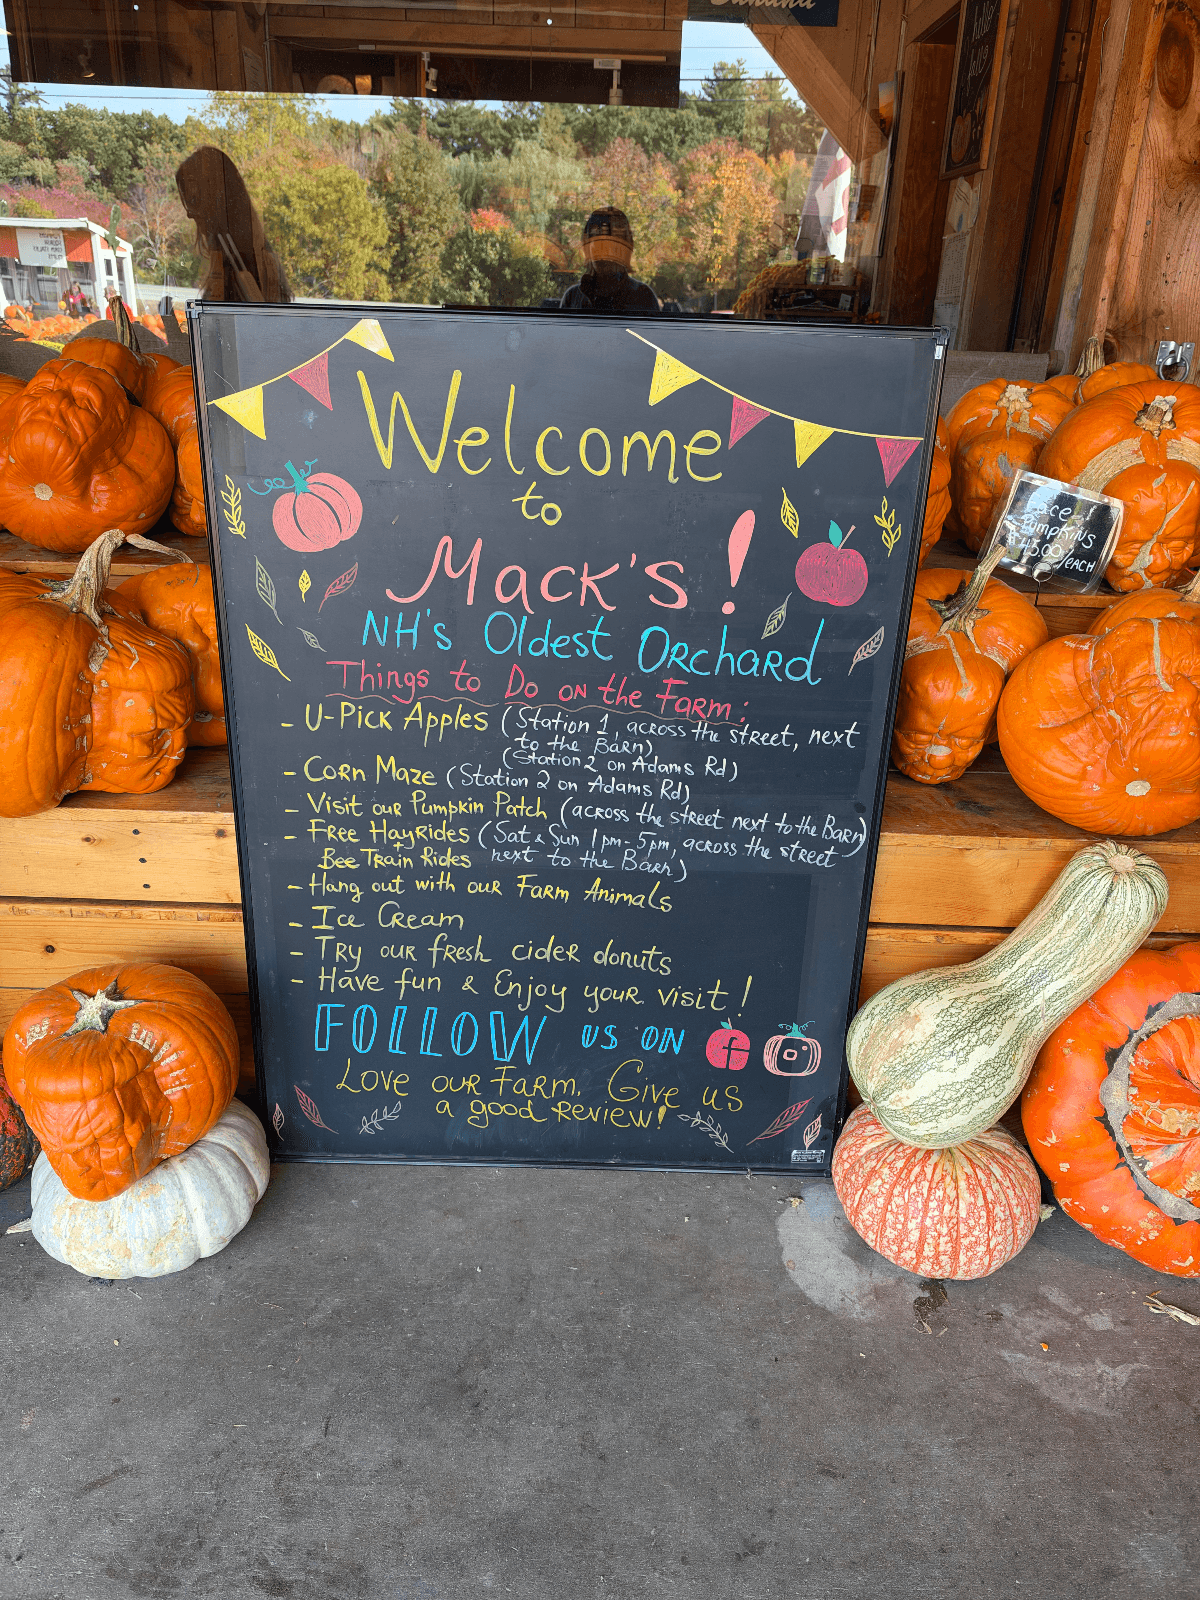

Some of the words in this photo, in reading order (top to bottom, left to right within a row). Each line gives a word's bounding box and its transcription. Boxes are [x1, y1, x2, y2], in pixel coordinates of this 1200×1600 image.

[357, 369, 722, 483] Welcome
[512, 481, 562, 525] to
[362, 608, 452, 650] NH's
[484, 611, 613, 661] Oldest
[326, 659, 430, 704] Things
[450, 659, 481, 692] to
[505, 664, 538, 698] Do
[598, 673, 642, 708] the
[403, 702, 489, 747] Apples
[501, 705, 590, 738] (Station
[627, 721, 687, 737] across
[692, 721, 720, 743] the
[808, 721, 860, 749] next
[514, 732, 540, 750] to
[547, 735, 581, 752] the
[376, 755, 438, 786] Maze
[446, 763, 528, 789] (Station
[536, 769, 551, 789] 2
[557, 779, 578, 792] on
[588, 774, 653, 797] Adams
[660, 778, 690, 804] Rd)
[502, 747, 581, 770] (Station
[584, 755, 599, 773] 2
[607, 759, 626, 772] on
[632, 754, 695, 776] Adams
[705, 755, 738, 782] Rd)
[307, 791, 364, 816] Visit
[409, 789, 484, 822] Pumpkin
[496, 791, 548, 820] Patch
[636, 801, 665, 828] the
[732, 812, 771, 833] next
[775, 812, 793, 835] to
[795, 815, 817, 837] the
[317, 848, 361, 869] Bee
[420, 846, 472, 868] Rides
[478, 821, 531, 849] (Sat
[534, 834, 546, 845] &
[549, 823, 580, 847] Sun
[683, 837, 738, 856] across
[744, 836, 773, 860] the
[491, 846, 539, 865] next
[547, 848, 571, 866] to
[580, 850, 615, 869] the
[309, 871, 364, 903] Hang
[372, 875, 406, 894] out
[415, 870, 456, 893] with
[584, 877, 672, 912] Animals
[312, 905, 365, 930] Ice
[593, 939, 671, 976] donuts
[319, 966, 384, 993] Have
[394, 967, 441, 1001] fun
[461, 975, 479, 995] &
[494, 969, 568, 1013] Enjoy
[315, 1004, 548, 1065] FOLLOW
[582, 1025, 619, 1050] US
[641, 1026, 686, 1055] ON
[336, 1058, 409, 1097] Love
[608, 1058, 681, 1109] Give
[702, 1085, 743, 1112] us
[436, 1100, 454, 1118] a
[467, 1100, 548, 1129] good
